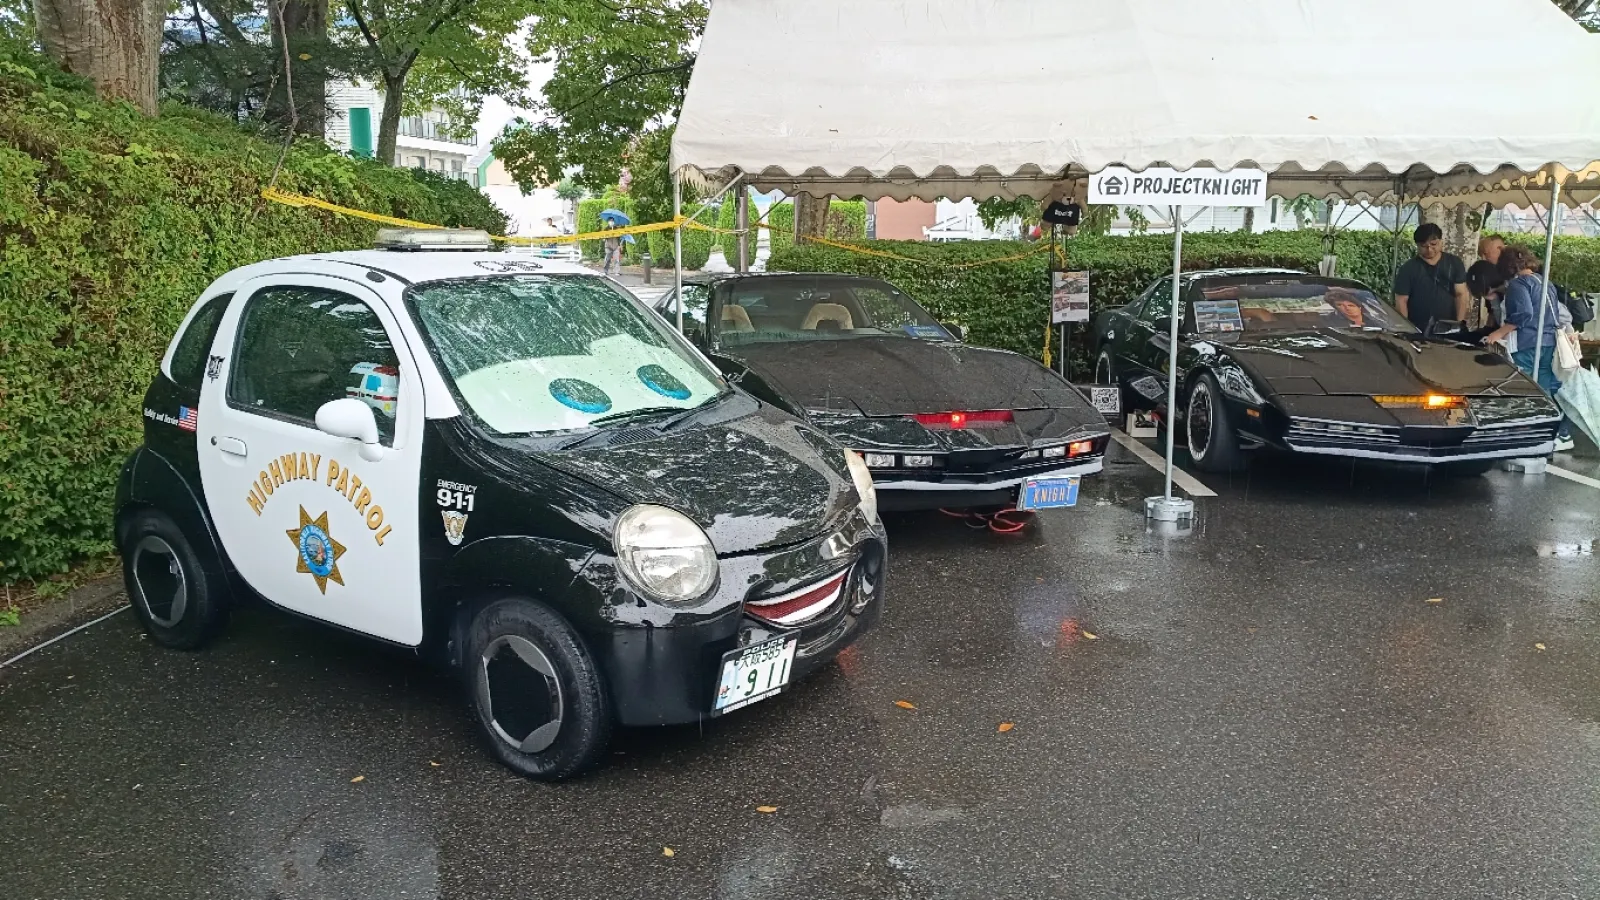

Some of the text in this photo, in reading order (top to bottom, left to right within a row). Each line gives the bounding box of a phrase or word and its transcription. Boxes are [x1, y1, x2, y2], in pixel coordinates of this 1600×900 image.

[1132, 177, 1262, 196] PROJECTKNIGHT
[437, 479, 478, 494] EMERGENCY
[1033, 486, 1072, 503] KNIGHT
[246, 452, 392, 546] HIGHWAY PATROL
